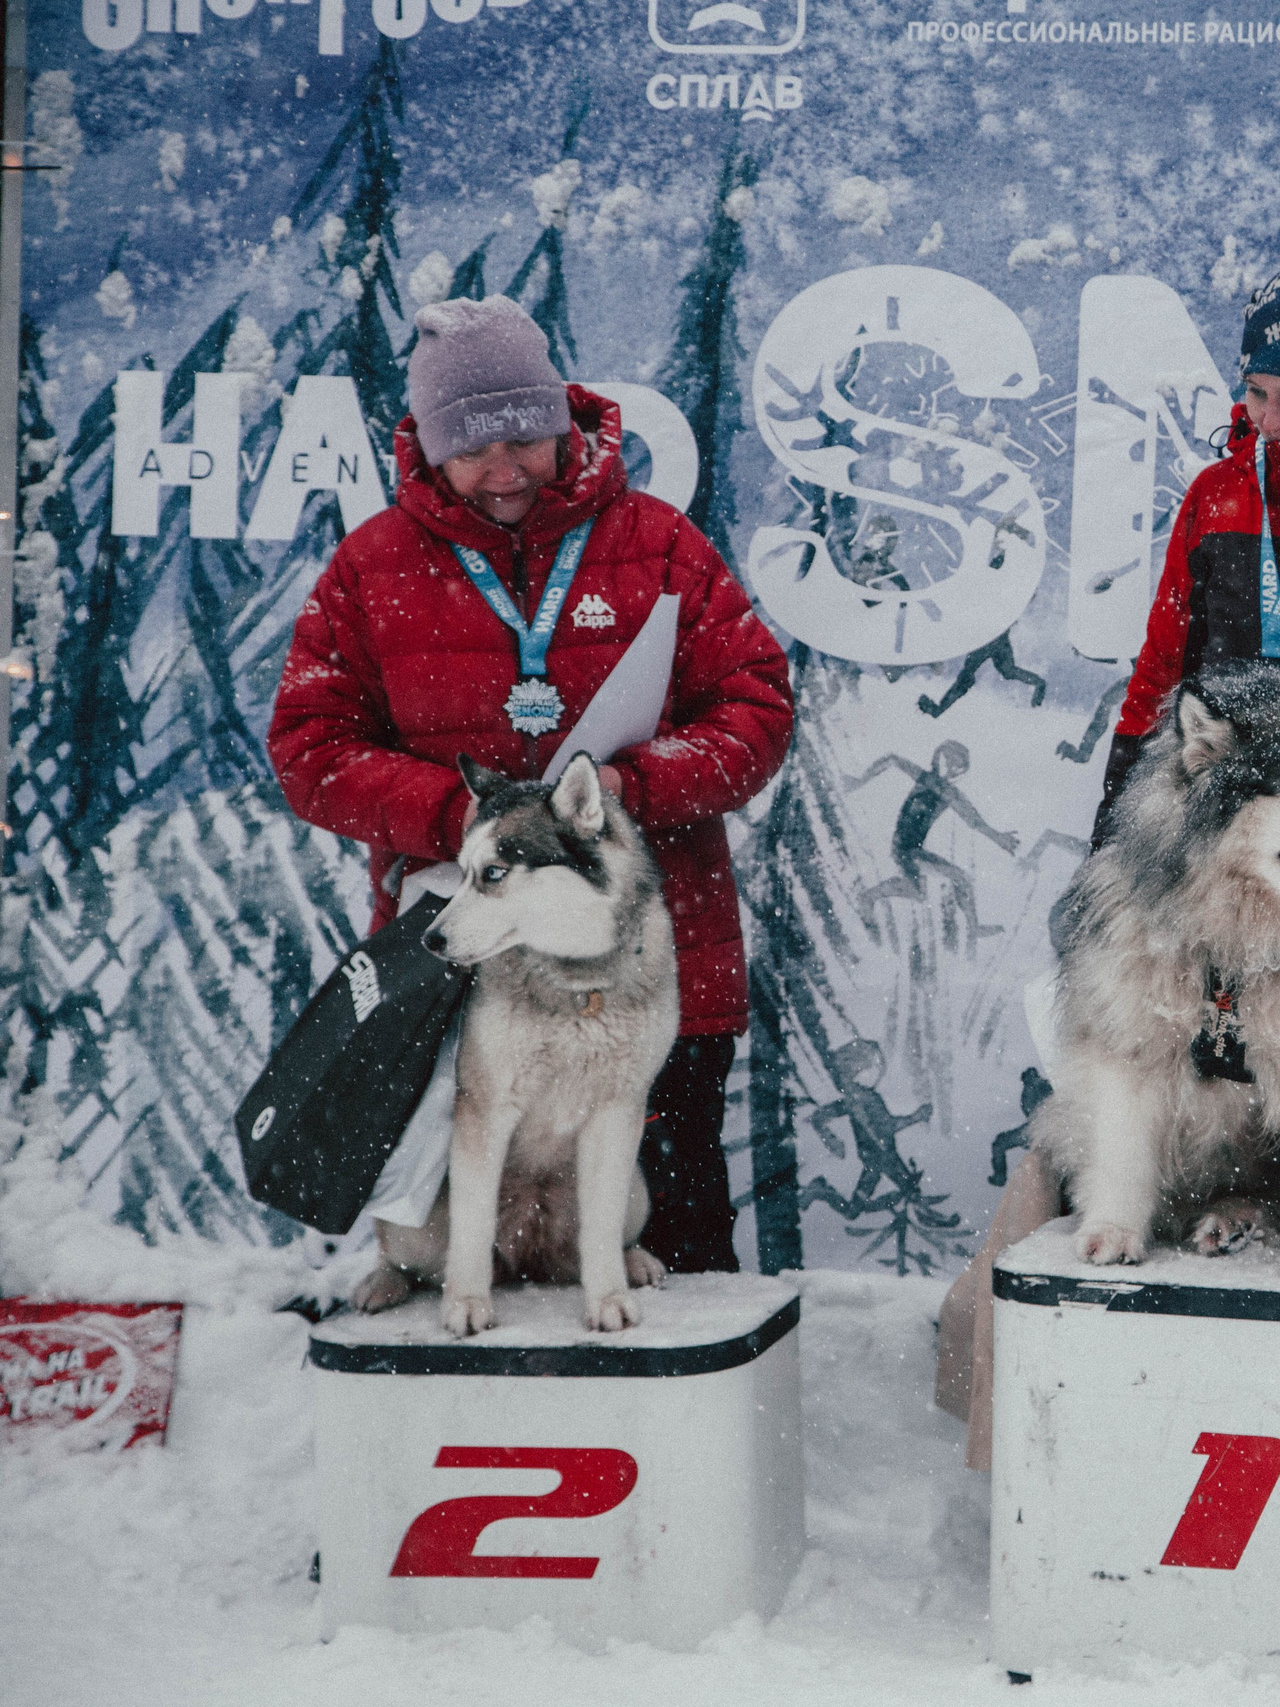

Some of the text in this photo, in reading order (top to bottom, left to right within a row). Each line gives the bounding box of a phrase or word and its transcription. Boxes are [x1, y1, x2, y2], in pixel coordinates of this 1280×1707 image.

[906, 20, 1197, 44] ПРОФЕССИОНАЛЬНЫЕ
[645, 73, 804, 111] СПЛАВ
[486, 588, 512, 619] SNOW
[1262, 559, 1277, 613] HARD
[534, 586, 566, 633] HARD
[573, 614, 616, 629] Kappa
[389, 1446, 638, 1578] 2
